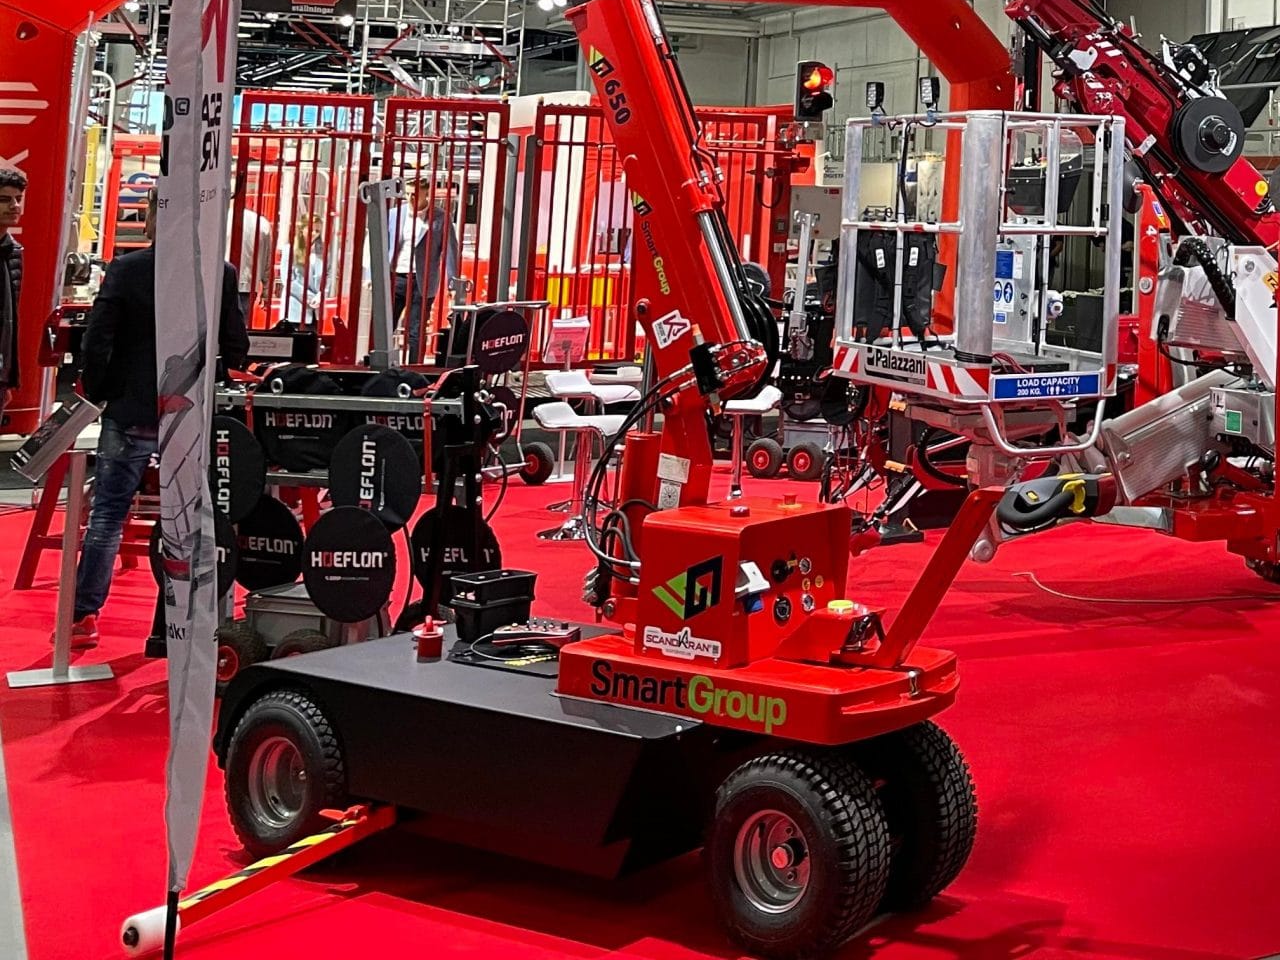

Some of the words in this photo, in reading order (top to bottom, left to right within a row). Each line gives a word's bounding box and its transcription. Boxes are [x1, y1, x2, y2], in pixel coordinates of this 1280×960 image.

[603, 78, 632, 127] 650
[481, 333, 524, 352] HOEFLON
[874, 349, 927, 376] Palazzani
[1016, 378, 1039, 388] LOAD
[1040, 376, 1081, 387] CAPACITY
[265, 411, 334, 429] HOEFLON
[359, 440, 377, 511] OEFLON
[239, 535, 295, 555] OEFLON
[311, 551, 384, 568] HOEFLON
[646, 630, 712, 653] SCANDKRAN
[590, 659, 788, 735] SmartGroup
